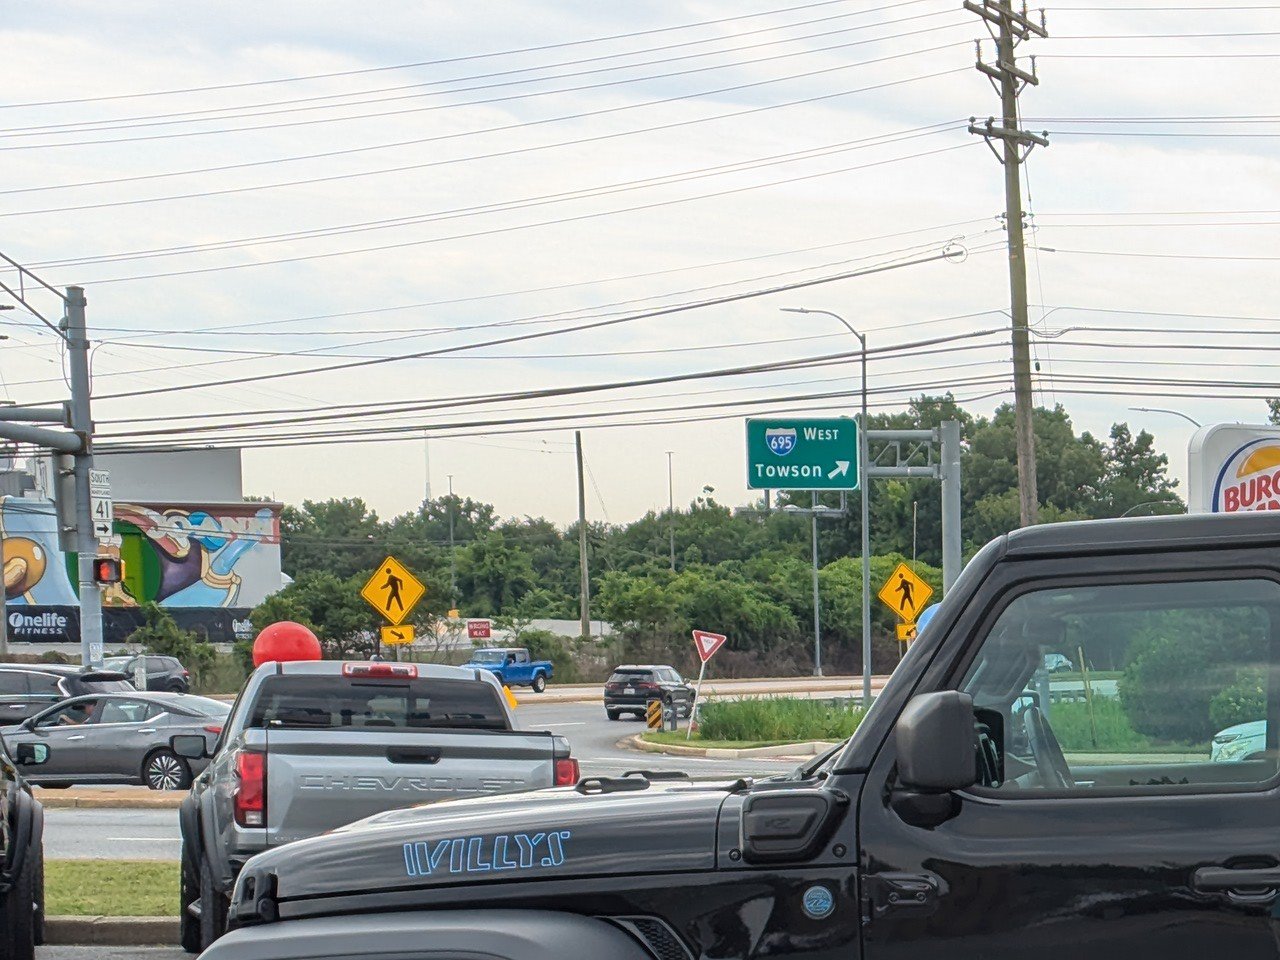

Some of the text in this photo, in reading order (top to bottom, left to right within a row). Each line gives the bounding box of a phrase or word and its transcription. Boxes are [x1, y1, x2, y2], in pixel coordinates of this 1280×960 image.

[771, 436, 792, 450] 695
[96, 500, 109, 518] 41
[9, 612, 67, 628] Onelife
[14, 627, 63, 635] FITNESS
[300, 774, 525, 793] CHEVROLET
[403, 831, 571, 876] WILLYS
